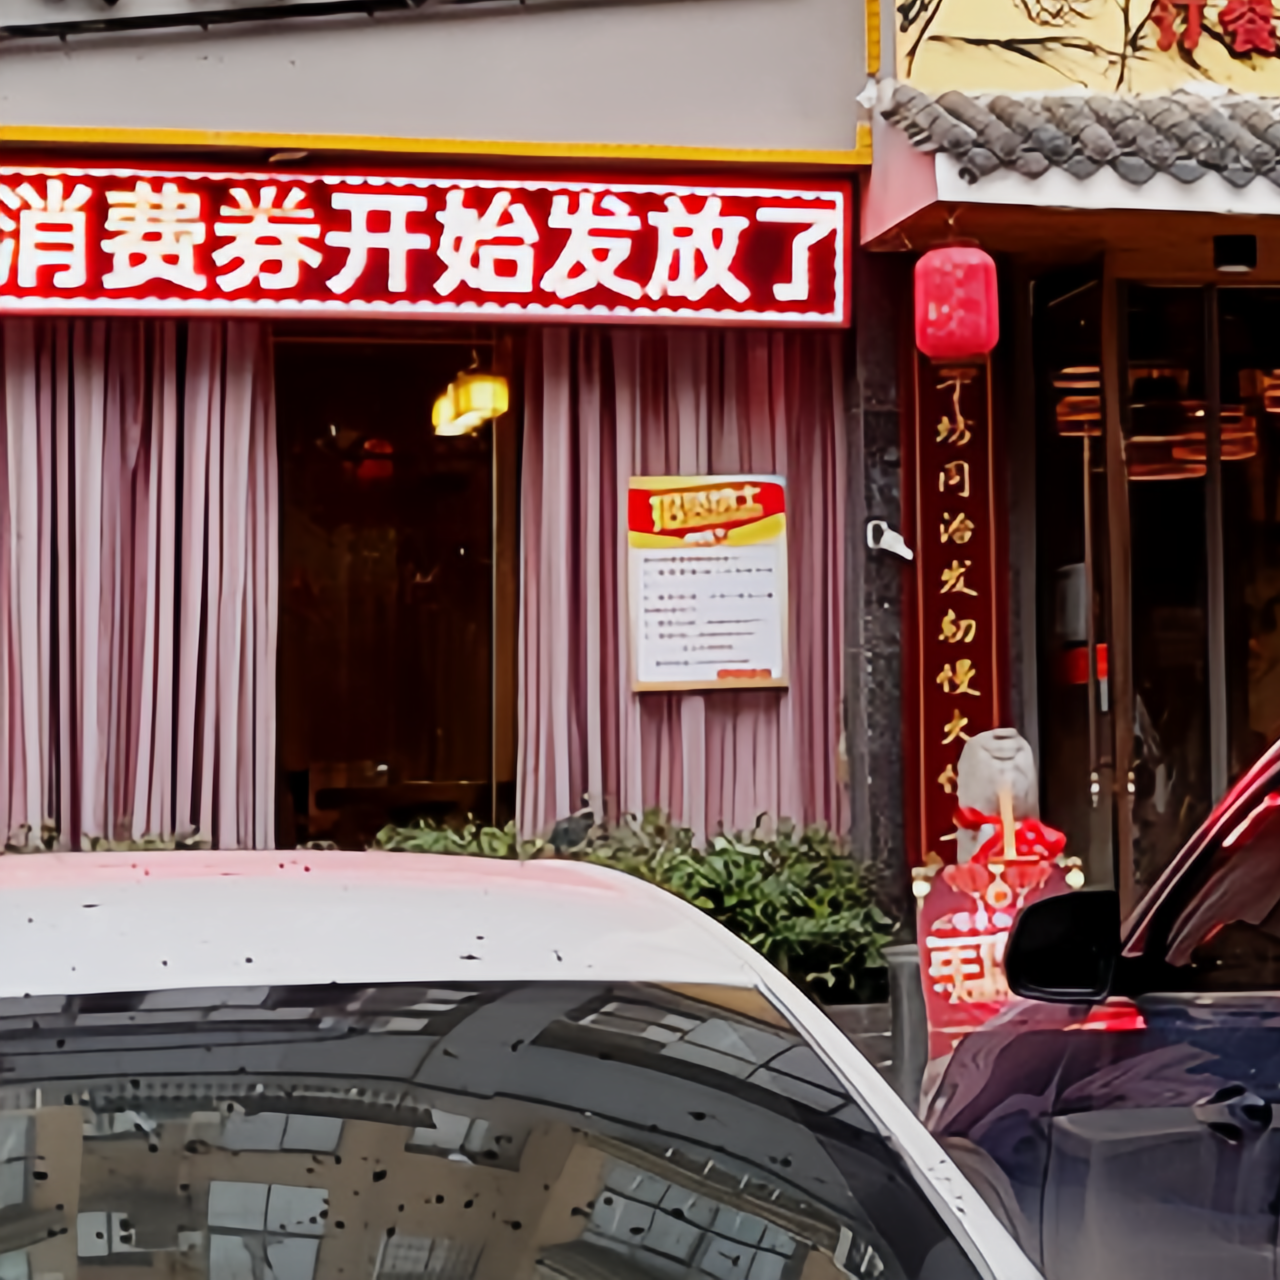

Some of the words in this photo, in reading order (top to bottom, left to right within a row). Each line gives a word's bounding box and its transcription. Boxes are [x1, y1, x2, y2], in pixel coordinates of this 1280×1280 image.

[0, 180, 838, 302] 消费券开始发放了
